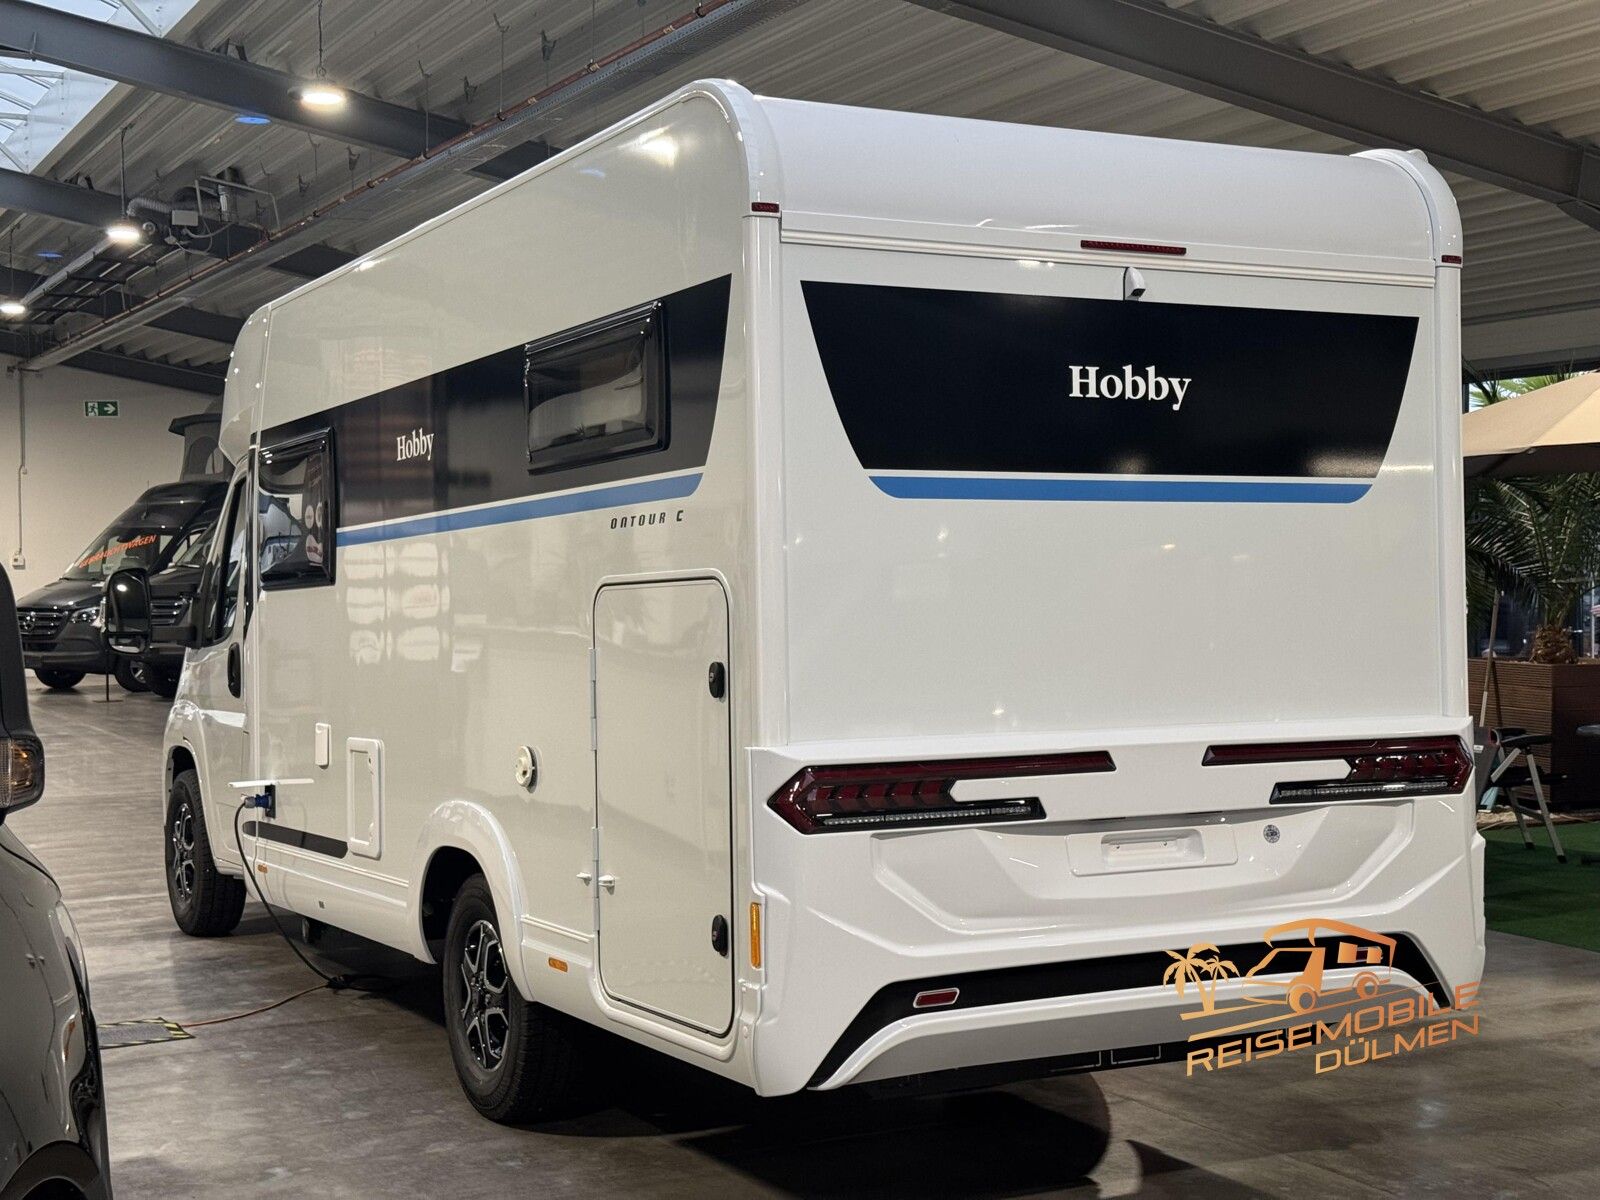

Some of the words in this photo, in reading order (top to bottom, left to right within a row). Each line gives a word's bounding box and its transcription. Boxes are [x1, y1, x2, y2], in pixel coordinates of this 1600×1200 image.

[1068, 364, 1192, 411] Hobby
[396, 427, 435, 462] Hobby
[676, 509, 684, 522] C
